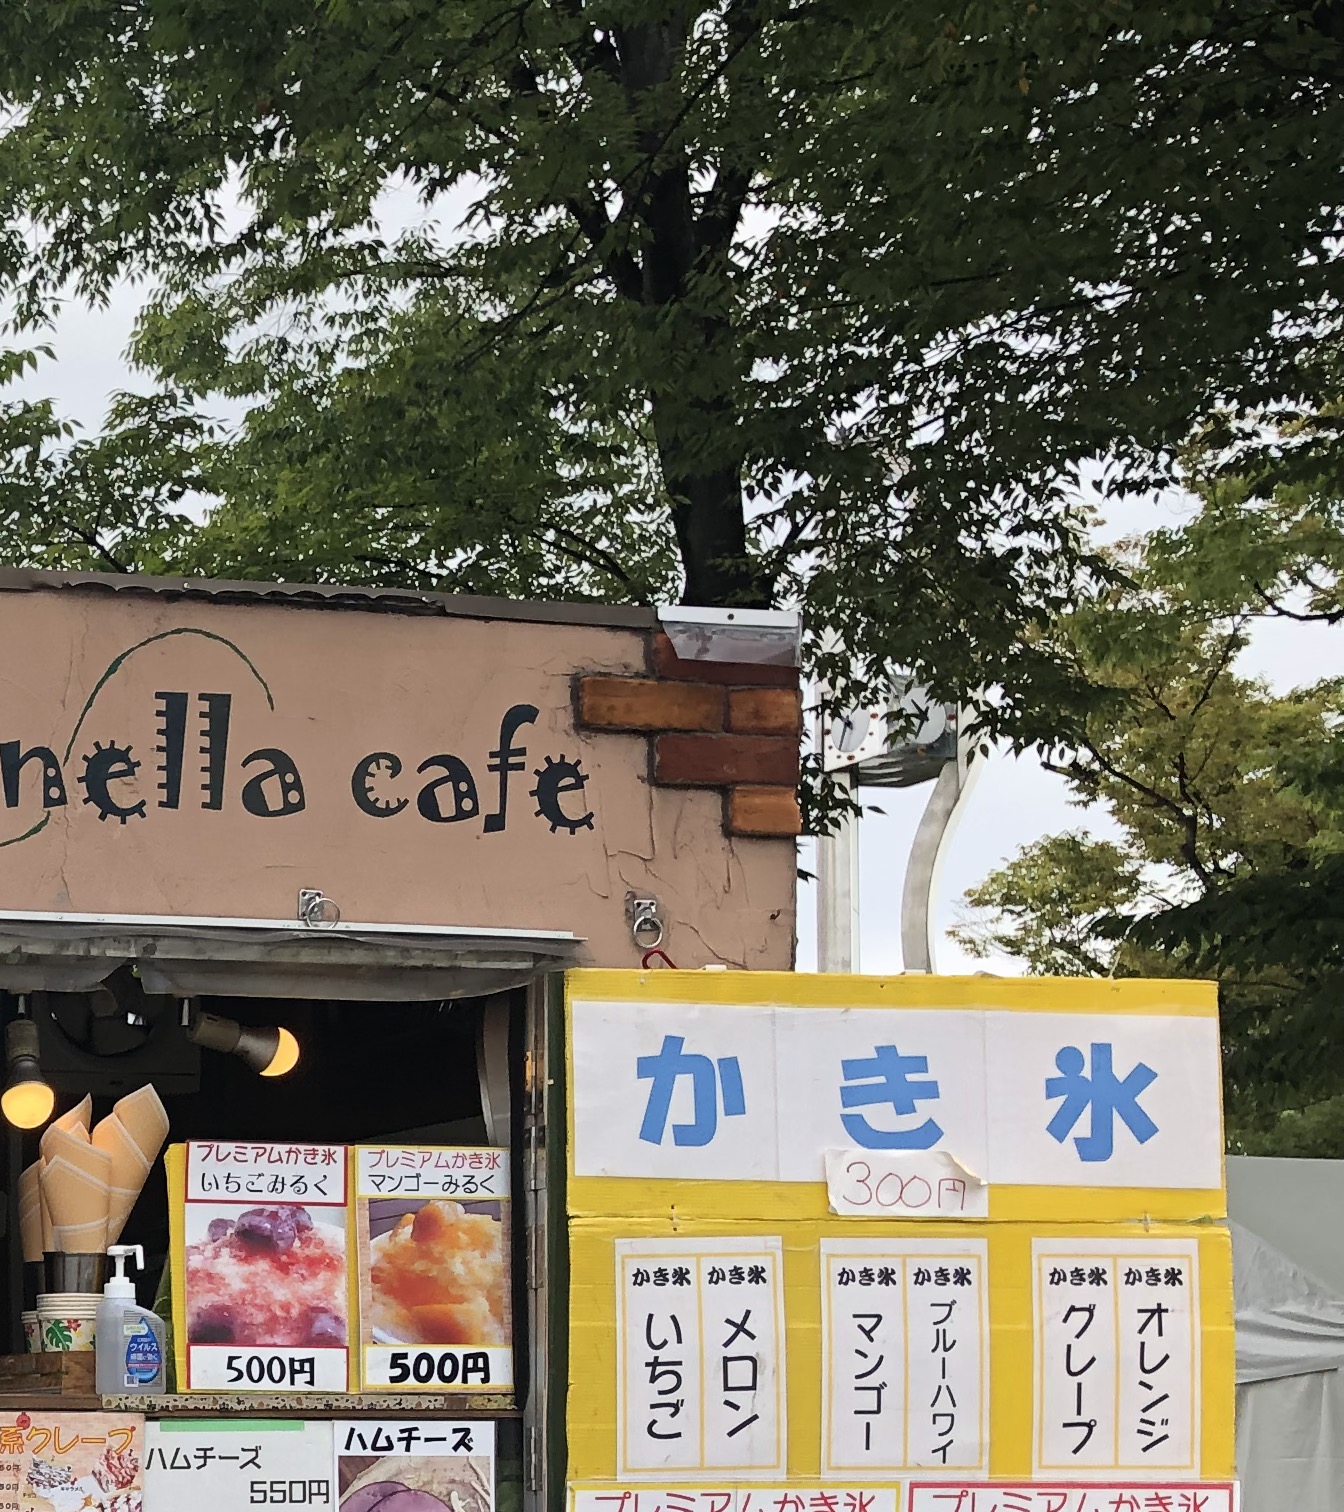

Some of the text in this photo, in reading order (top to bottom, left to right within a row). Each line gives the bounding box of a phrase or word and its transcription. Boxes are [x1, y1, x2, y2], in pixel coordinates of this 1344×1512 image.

[350, 704, 595, 837] cafe
[636, 1034, 1160, 1162] かき氷
[197, 1143, 338, 1166] プレミアムかき氷
[367, 1150, 502, 1171] プレミアムかき氷
[201, 1171, 328, 1197] いちごみるく
[367, 1172, 495, 1195] マンゴーみるく
[843, 1161, 966, 1211] 300円
[632, 1266, 692, 1287] かき氷
[707, 1266, 767, 1287] かき氷
[837, 1266, 897, 1287] かき氷
[912, 1266, 973, 1287] かき氷
[1048, 1266, 1108, 1287] かき氷
[1124, 1266, 1184, 1287] かき氷
[129, 1342, 158, 1352] ウイルス
[226, 1355, 315, 1387] 500円
[388, 1352, 492, 1385] 500円
[645, 1312, 683, 1441] いちご
[722, 1307, 759, 1438] メロン
[852, 1312, 885, 1451] マンゴー
[1061, 1302, 1097, 1454] グレープ
[1136, 1302, 1169, 1453] オレンジ
[930, 1301, 957, 1464] ブルーハワイ
[344, 1426, 474, 1453] ハムチーズ
[145, 1445, 262, 1470] ハムチーズ
[250, 1480, 330, 1505] 550円
